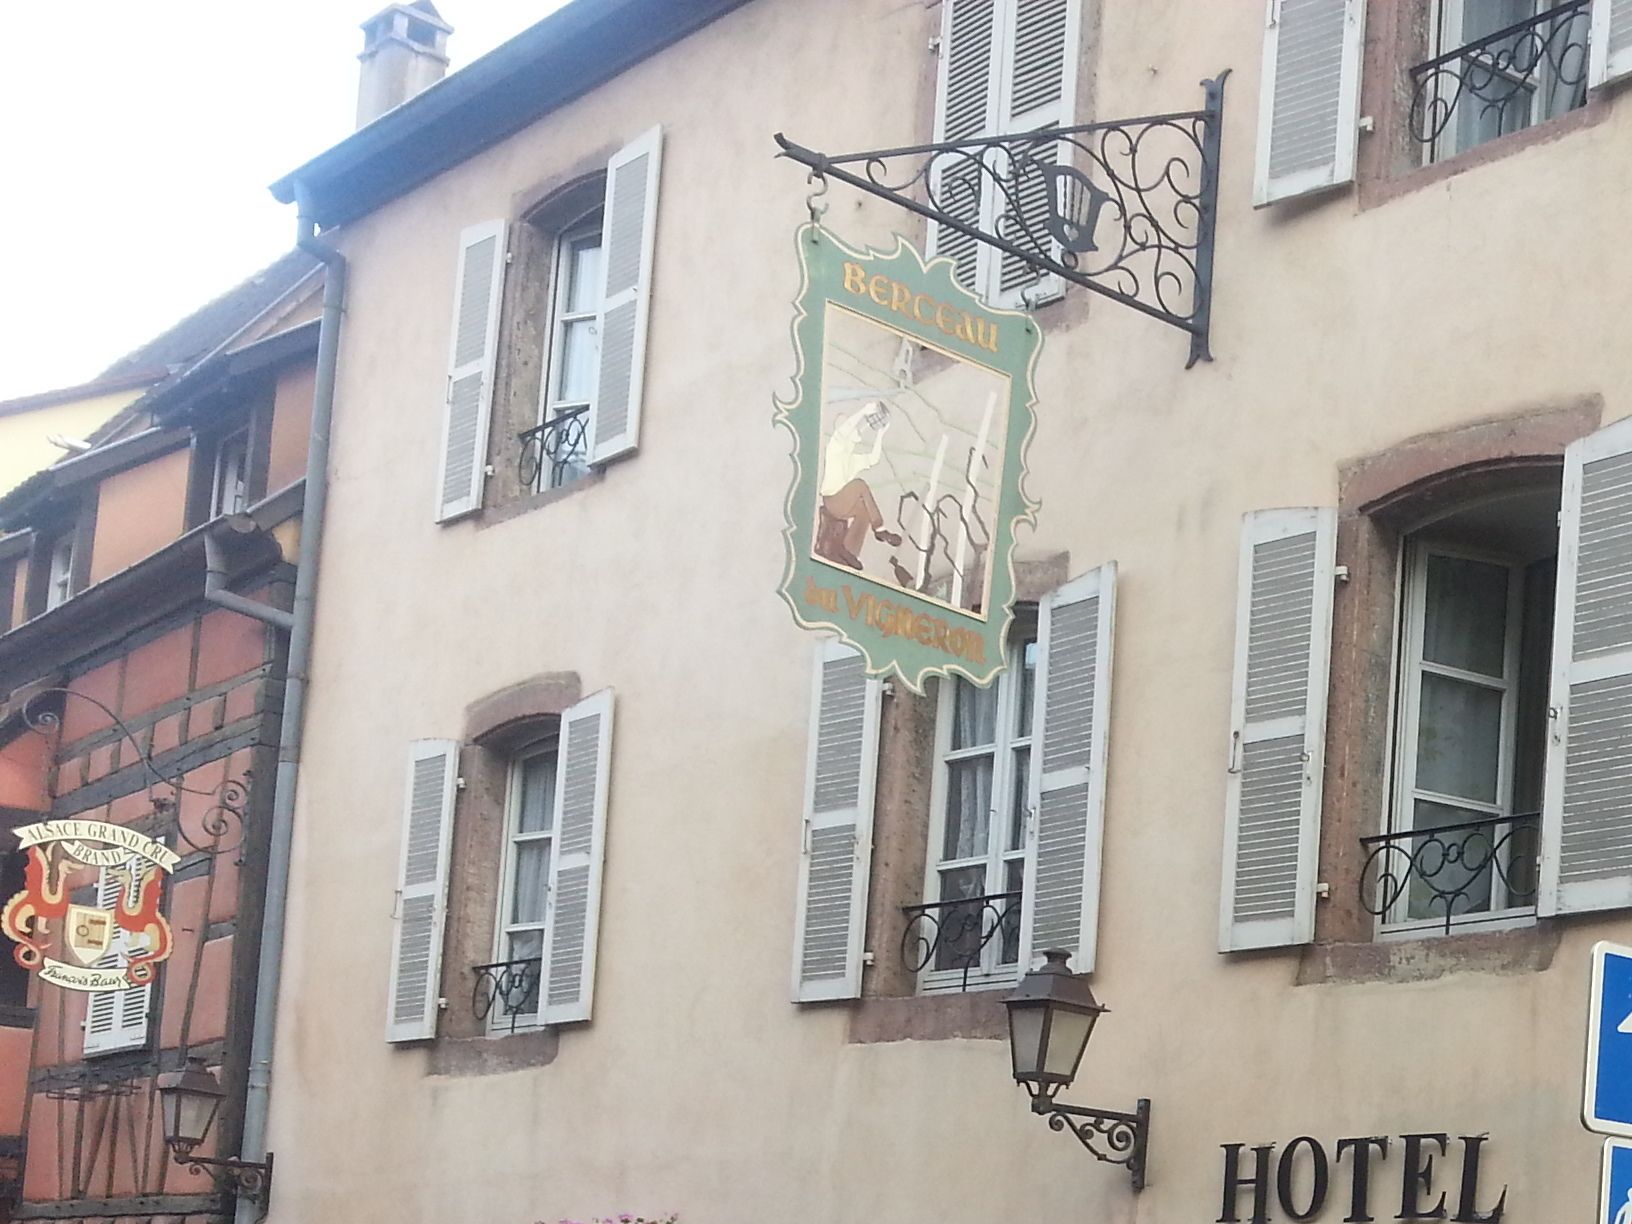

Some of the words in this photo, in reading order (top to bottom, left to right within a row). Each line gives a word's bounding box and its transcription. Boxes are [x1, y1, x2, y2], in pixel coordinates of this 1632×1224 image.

[843, 262, 998, 352] BERCEAU
[841, 585, 986, 665] VIGNERON
[27, 822, 82, 841] ALSACE
[87, 825, 139, 848] GRAND
[142, 841, 169, 862] CRU
[73, 844, 122, 864] BRAND
